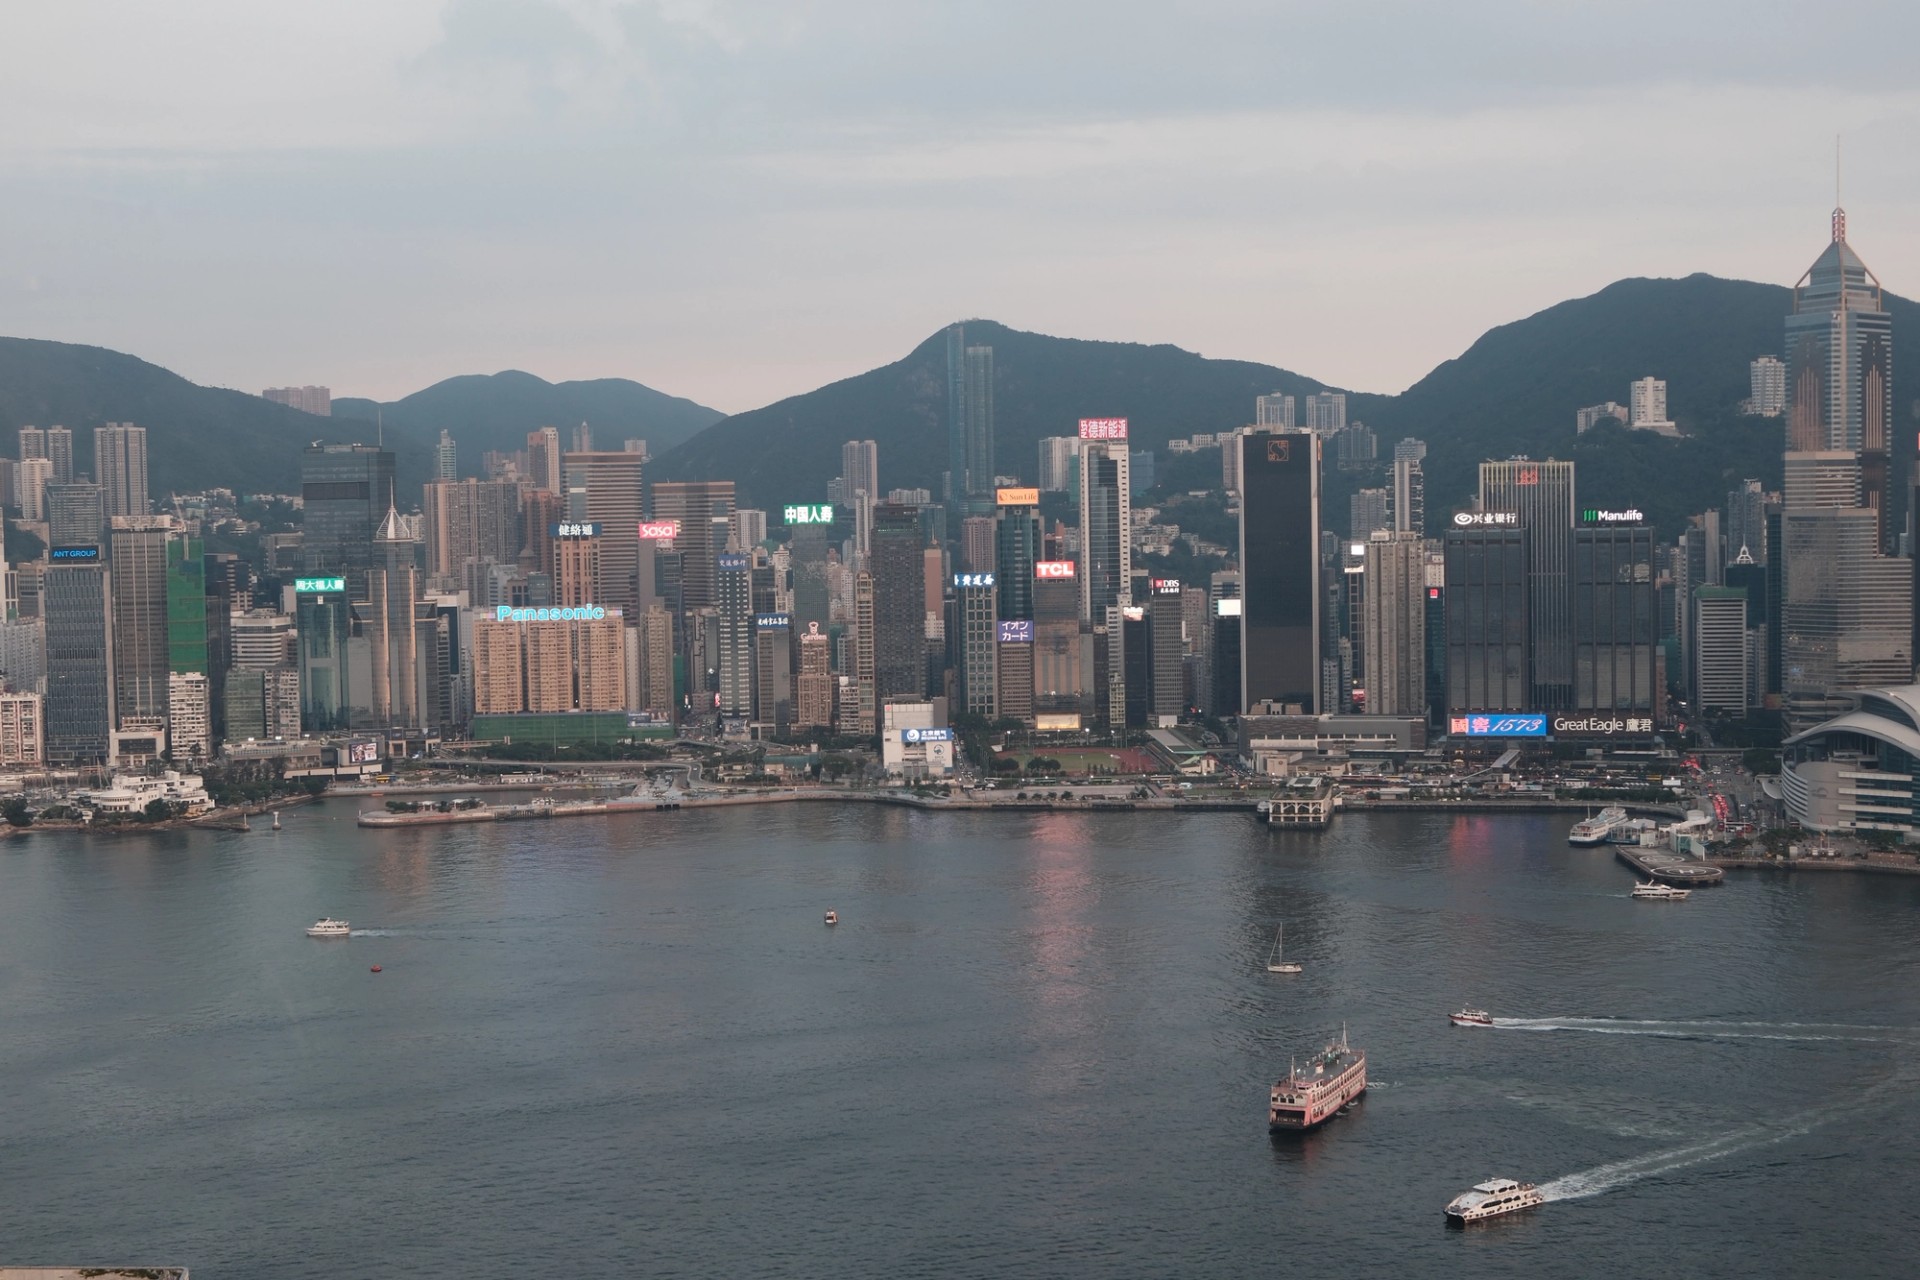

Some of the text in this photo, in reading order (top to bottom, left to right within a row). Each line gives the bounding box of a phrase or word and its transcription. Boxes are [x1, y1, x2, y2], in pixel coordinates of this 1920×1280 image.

[1472, 513, 1516, 524] 兴业银行
[1598, 509, 1643, 521] Manulife
[1037, 563, 1073, 576] TCL
[1163, 579, 1180, 587] DBS
[497, 603, 605, 621] Panasonic
[1001, 621, 1029, 630] イオン
[800, 632, 827, 641] Garden
[1002, 631, 1029, 641] カード
[1451, 717, 1543, 734] 國窖 1573
[1554, 717, 1653, 734] Great Eagle 鷹君
